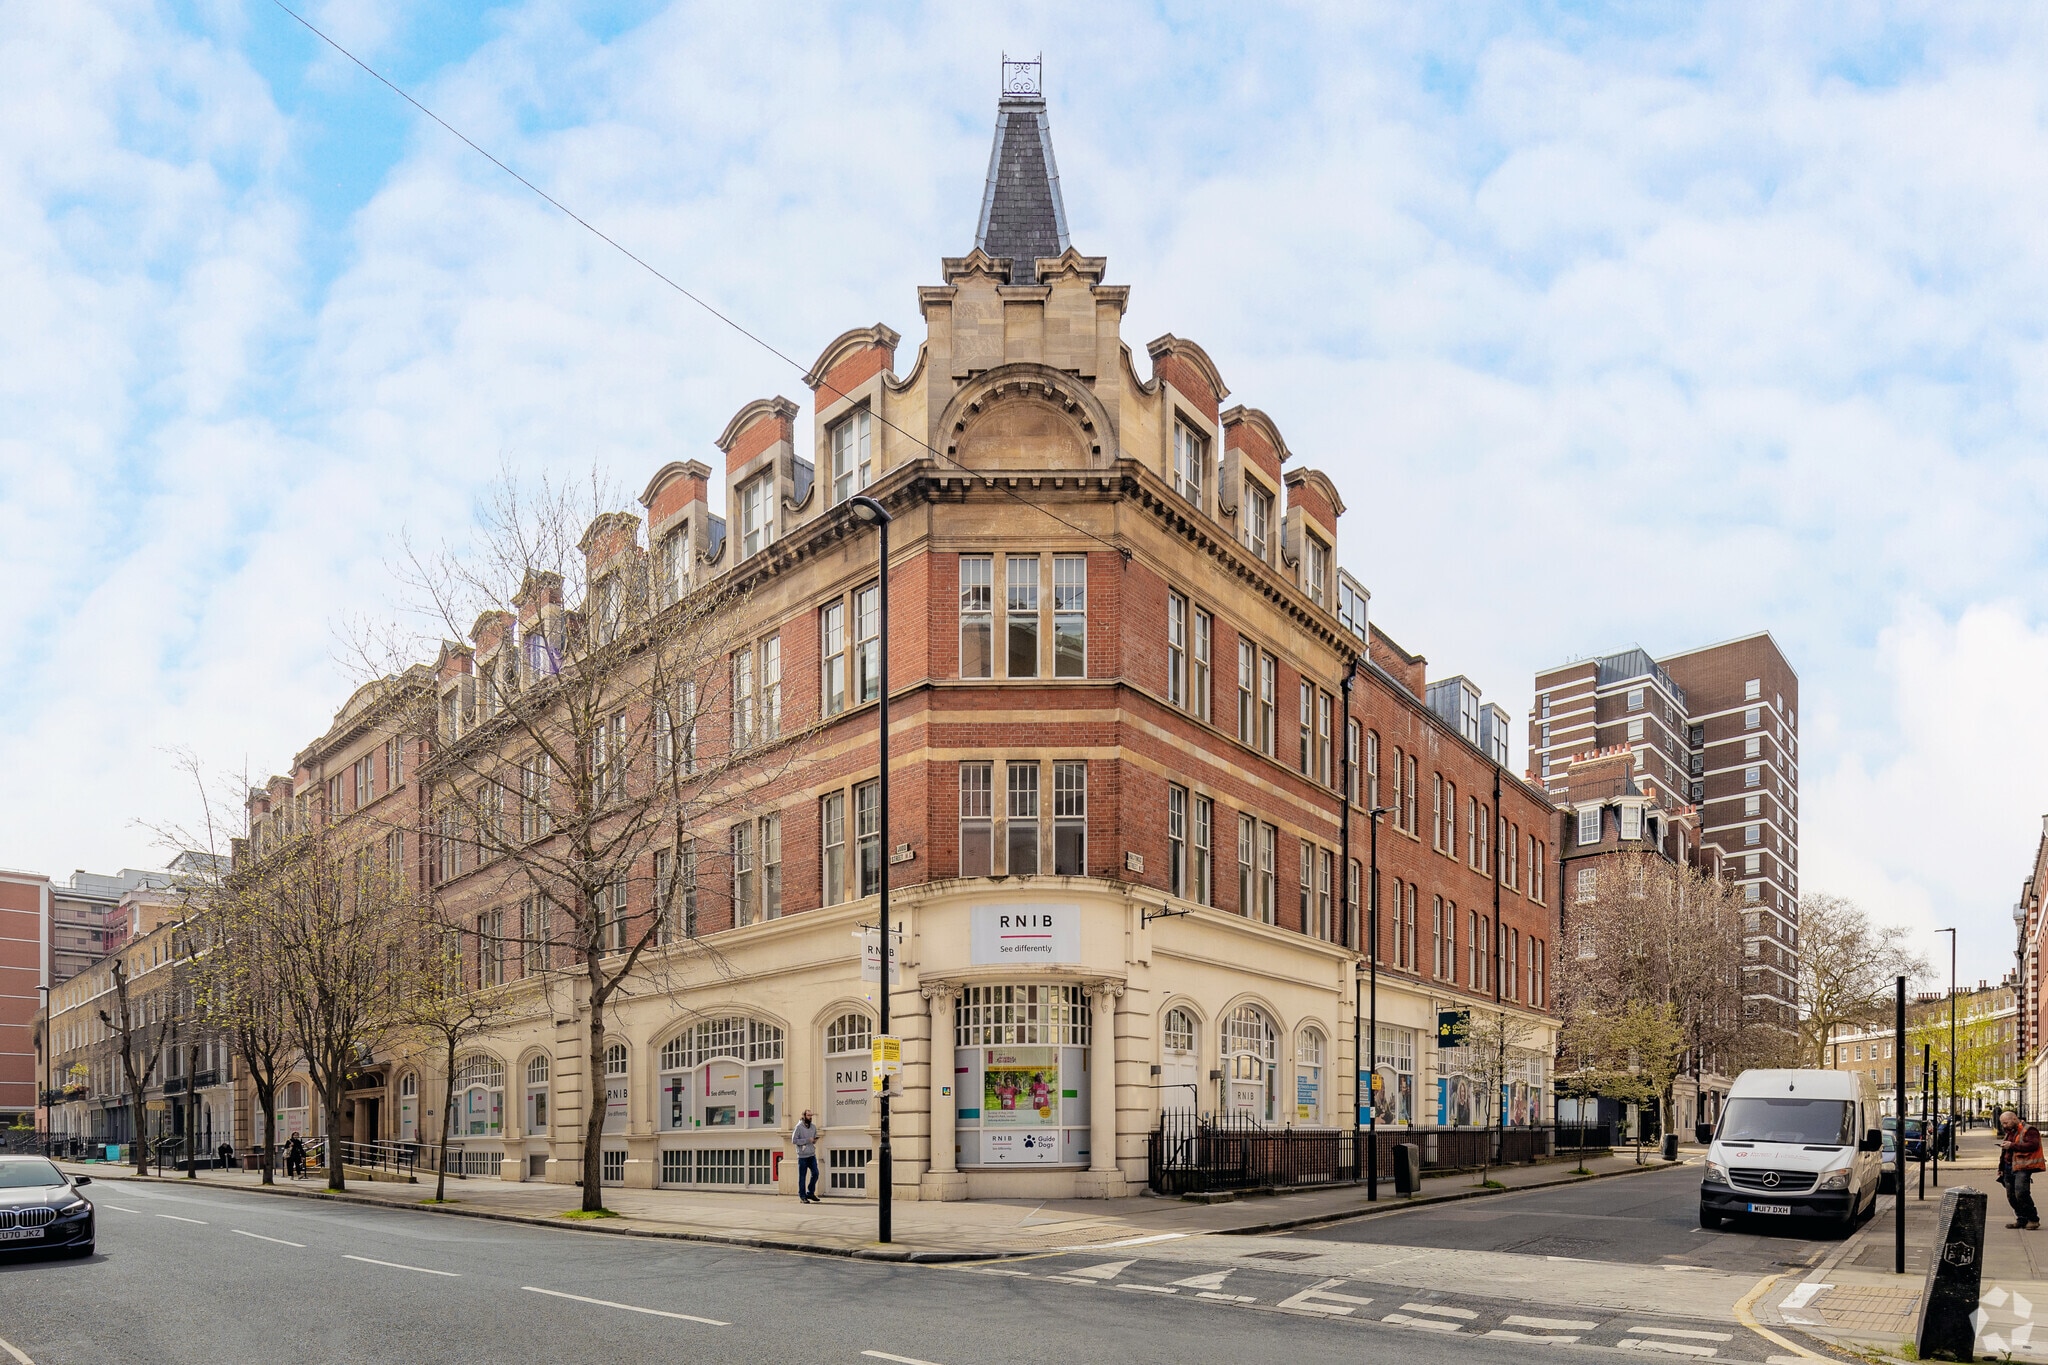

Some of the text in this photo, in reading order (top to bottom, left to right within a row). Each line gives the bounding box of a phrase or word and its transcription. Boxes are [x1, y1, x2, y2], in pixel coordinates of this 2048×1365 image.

[1000, 915, 1053, 928] RNIB
[867, 945, 894, 957] RNB
[1000, 945, 1052, 953] See differently
[836, 1070, 868, 1084] RNIB
[607, 1088, 628, 1099] RNIB
[718, 1089, 737, 1097] differently
[1237, 1091, 1255, 1101] RNIB
[845, 1098, 868, 1107] differently
[1754, 1204, 1788, 1214] WU17 DXH
[23, 1229, 41, 1238] JKZ
